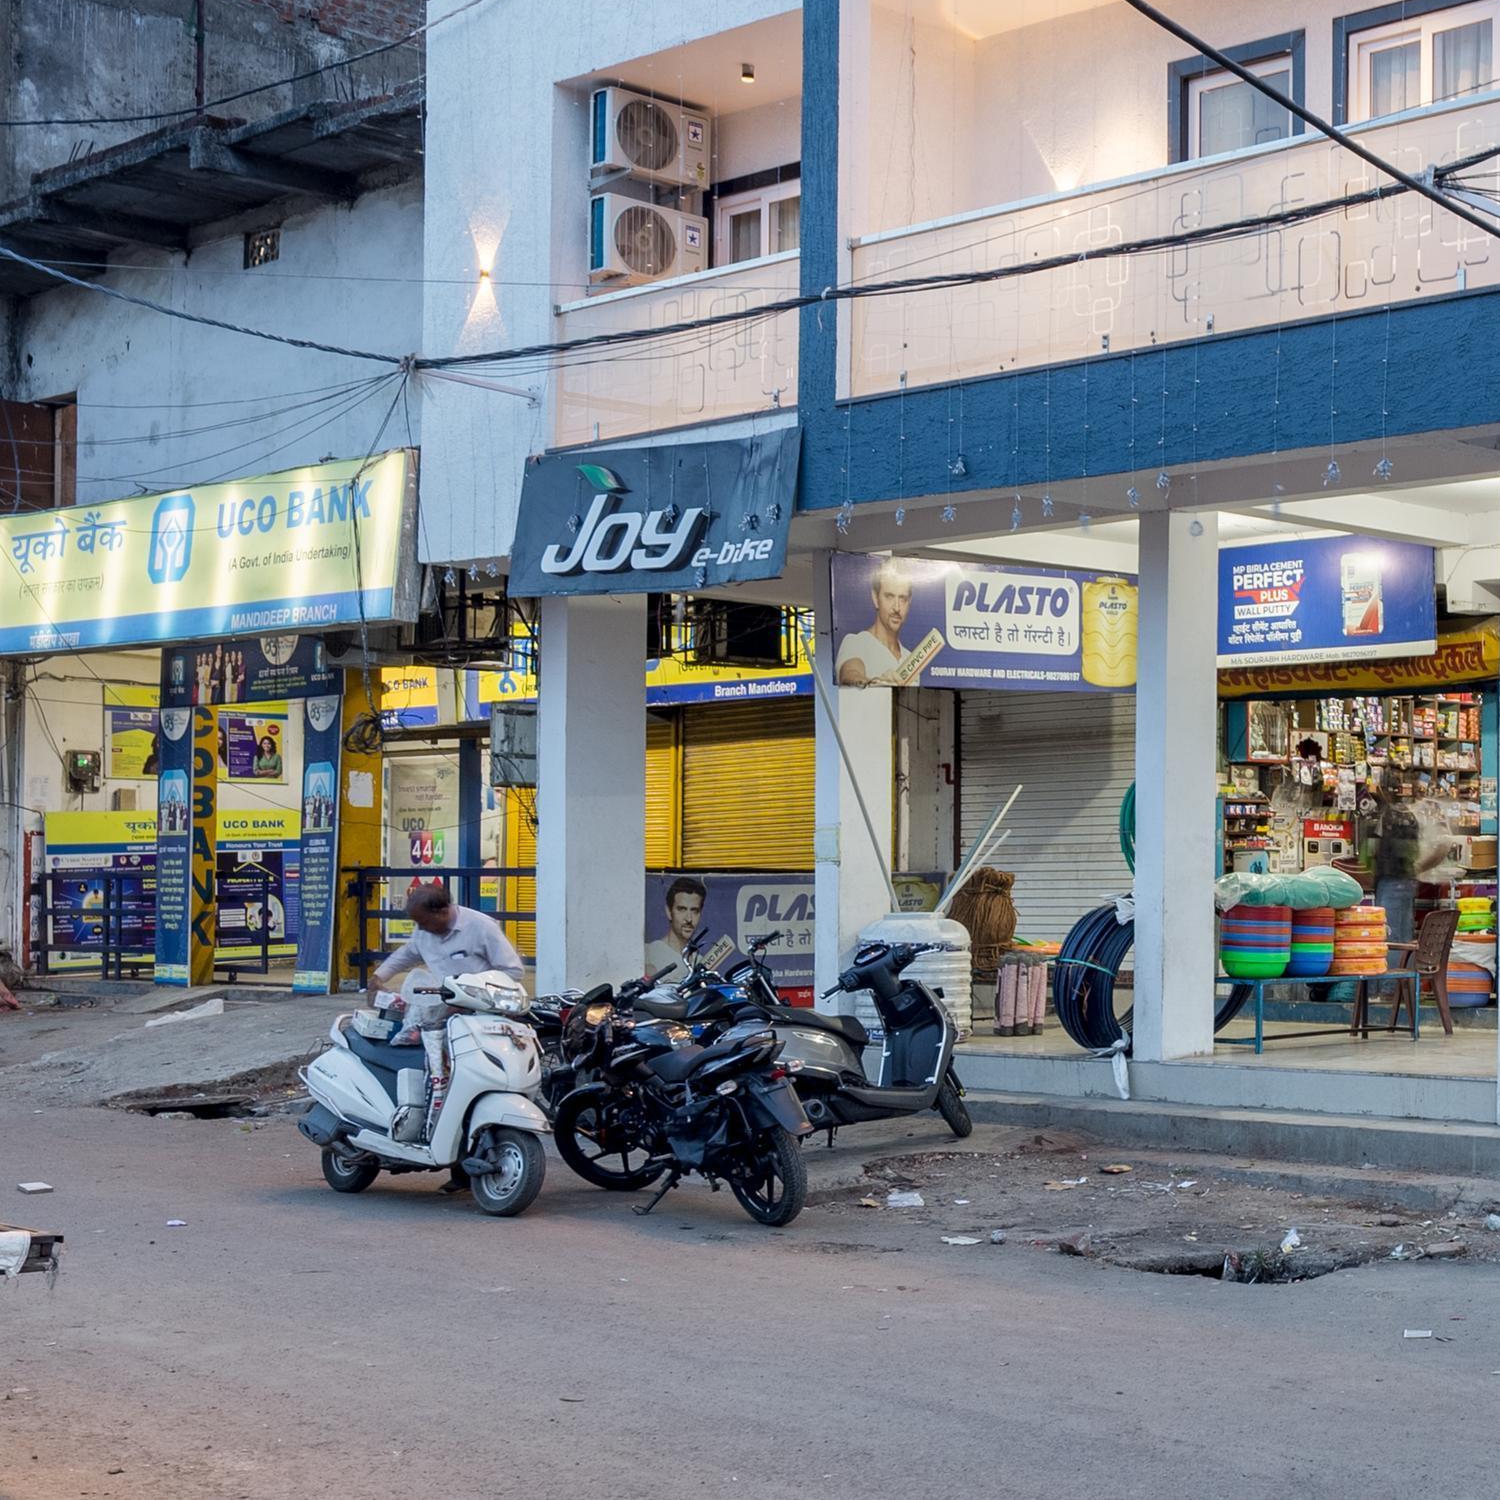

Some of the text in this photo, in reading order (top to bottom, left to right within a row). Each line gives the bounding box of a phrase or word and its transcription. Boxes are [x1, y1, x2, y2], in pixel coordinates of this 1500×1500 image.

[217, 480, 373, 538] UCO BANK
[12, 511, 127, 574] यूको बैंक
[541, 494, 774, 574] Joy e-bike
[239, 555, 261, 569] Govt.
[263, 554, 272, 566] of
[273, 550, 294, 564] India
[296, 543, 352, 562] Undertaking)
[1233, 560, 1303, 575] MP BIRLA CEMENT
[1233, 569, 1304, 591] PERFECT
[952, 579, 1070, 618] PLASTO
[1260, 589, 1288, 603] PLUS
[1099, 601, 1128, 611] PLASTO
[1237, 604, 1291, 617] WALL PUTTY
[231, 604, 338, 629] MANDIDEEP BRANCH
[953, 621, 990, 642] प्लास्टो
[994, 621, 1003, 643] है
[1007, 623, 1019, 643] तो
[906, 635, 938, 672] CPVC PIPE
[1244, 656, 1280, 665] SOURABH
[1281, 653, 1324, 663] HARDWARE
[957, 668, 992, 678] HARDWARE
[993, 669, 1005, 679] AND
[403, 677, 429, 690] BANK
[715, 681, 797, 697] Branch Mandideep
[125, 818, 157, 834] यूको
[223, 819, 285, 829] UCO BANK
[402, 817, 425, 832] UCO
[798, 928, 811, 946] तो
[714, 940, 729, 958] PIPE
